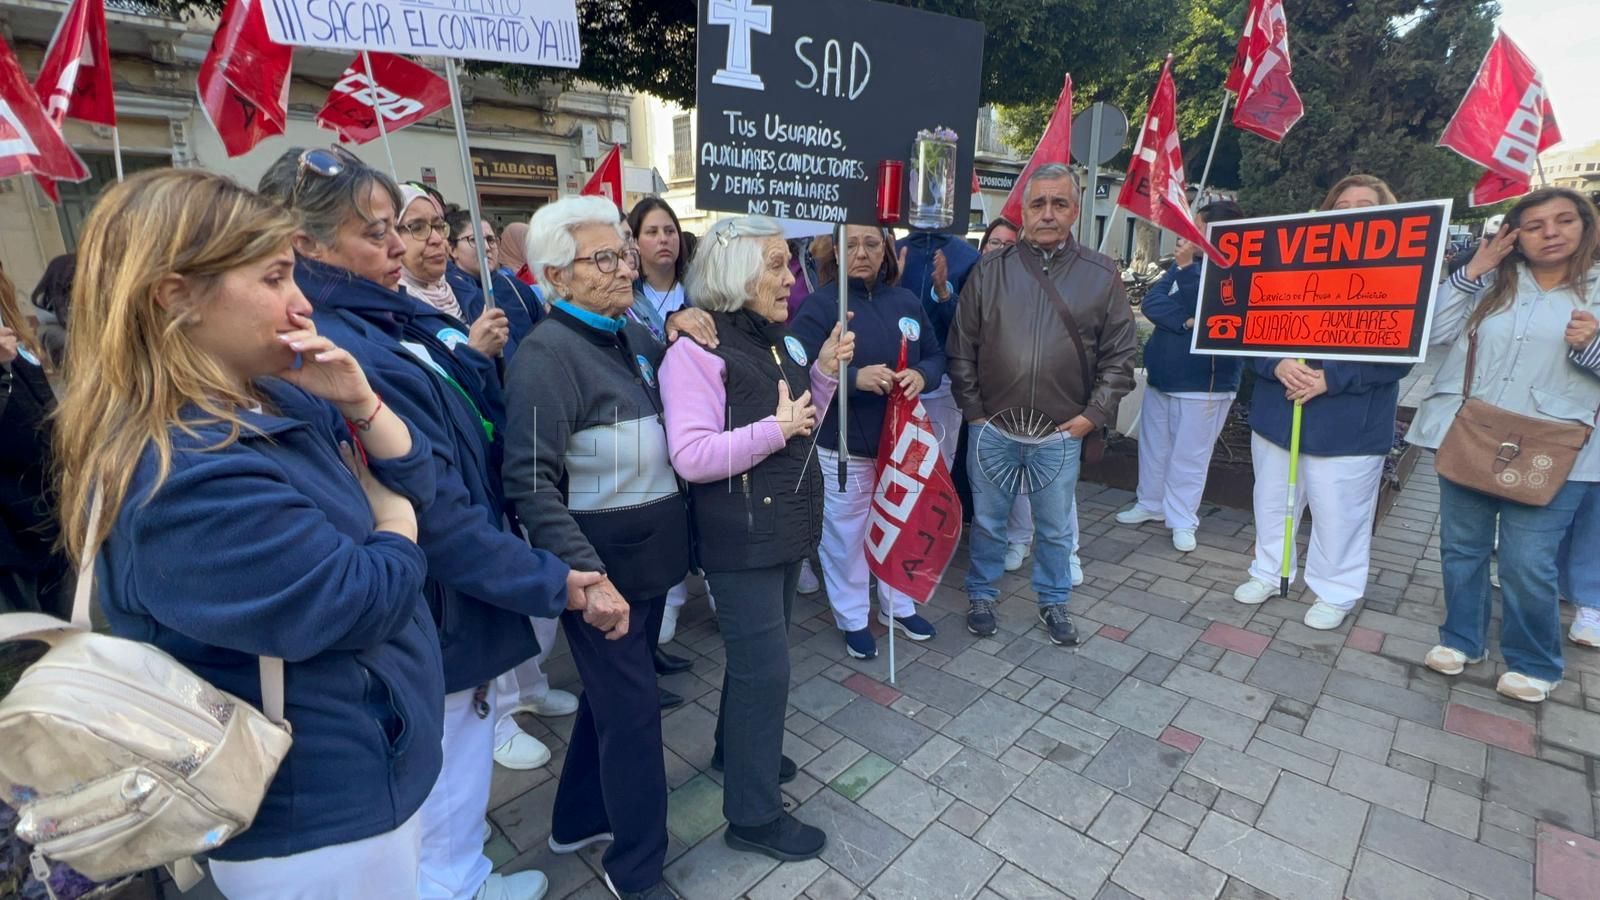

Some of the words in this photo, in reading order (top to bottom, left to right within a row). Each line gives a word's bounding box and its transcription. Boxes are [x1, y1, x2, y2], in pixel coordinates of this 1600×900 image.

[403, 10, 438, 48] EL
[438, 14, 530, 52] CONTRATO
[530, 16, 580, 63] YA!!!
[795, 36, 871, 100] S.A.D
[492, 161, 555, 177] TABACOS
[709, 172, 720, 191] Y
[725, 171, 765, 195] DEMÁS
[769, 175, 840, 202] FAMILIARES
[748, 199, 768, 214] NO
[772, 200, 790, 218] TE
[795, 200, 848, 222] OLVIDAN
[1218, 229, 1265, 268] SE
[1277, 215, 1431, 264] VENDE
[1245, 312, 1311, 342] USUARIOS
[1320, 310, 1400, 330] AUXILIARES
[1313, 330, 1402, 345] CONDUCTORES
